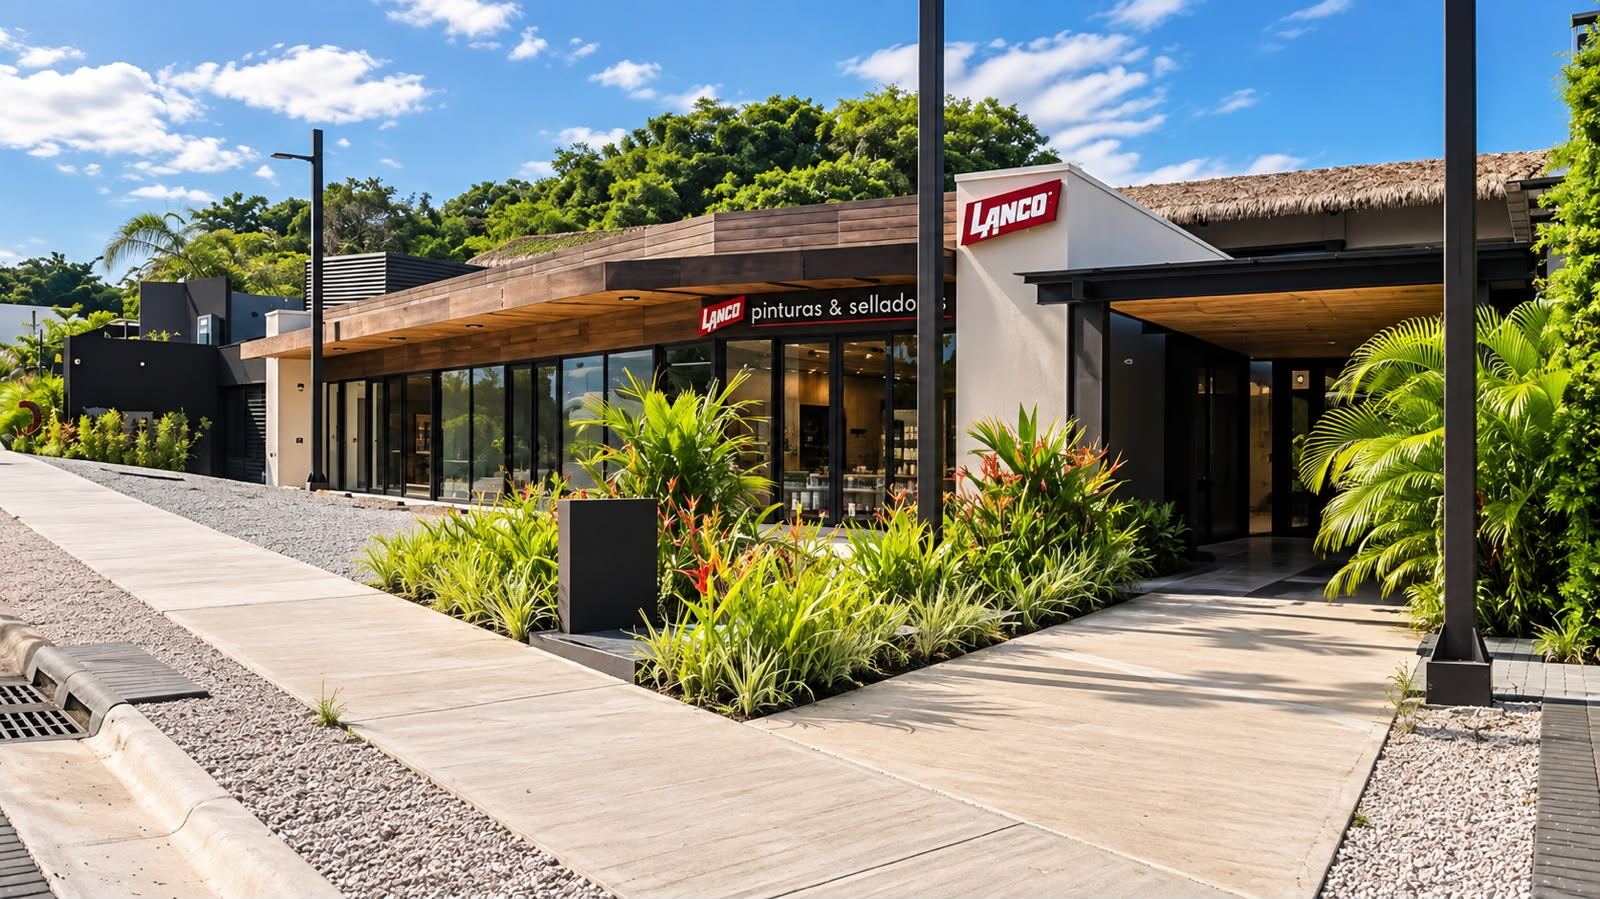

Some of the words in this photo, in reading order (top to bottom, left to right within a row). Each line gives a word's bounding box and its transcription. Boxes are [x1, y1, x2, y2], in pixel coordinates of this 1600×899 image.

[970, 193, 1047, 238] LANCO
[702, 302, 741, 332] LANCO
[751, 301, 822, 324] pinturas
[829, 298, 842, 316] &
[849, 292, 946, 315] sellados
